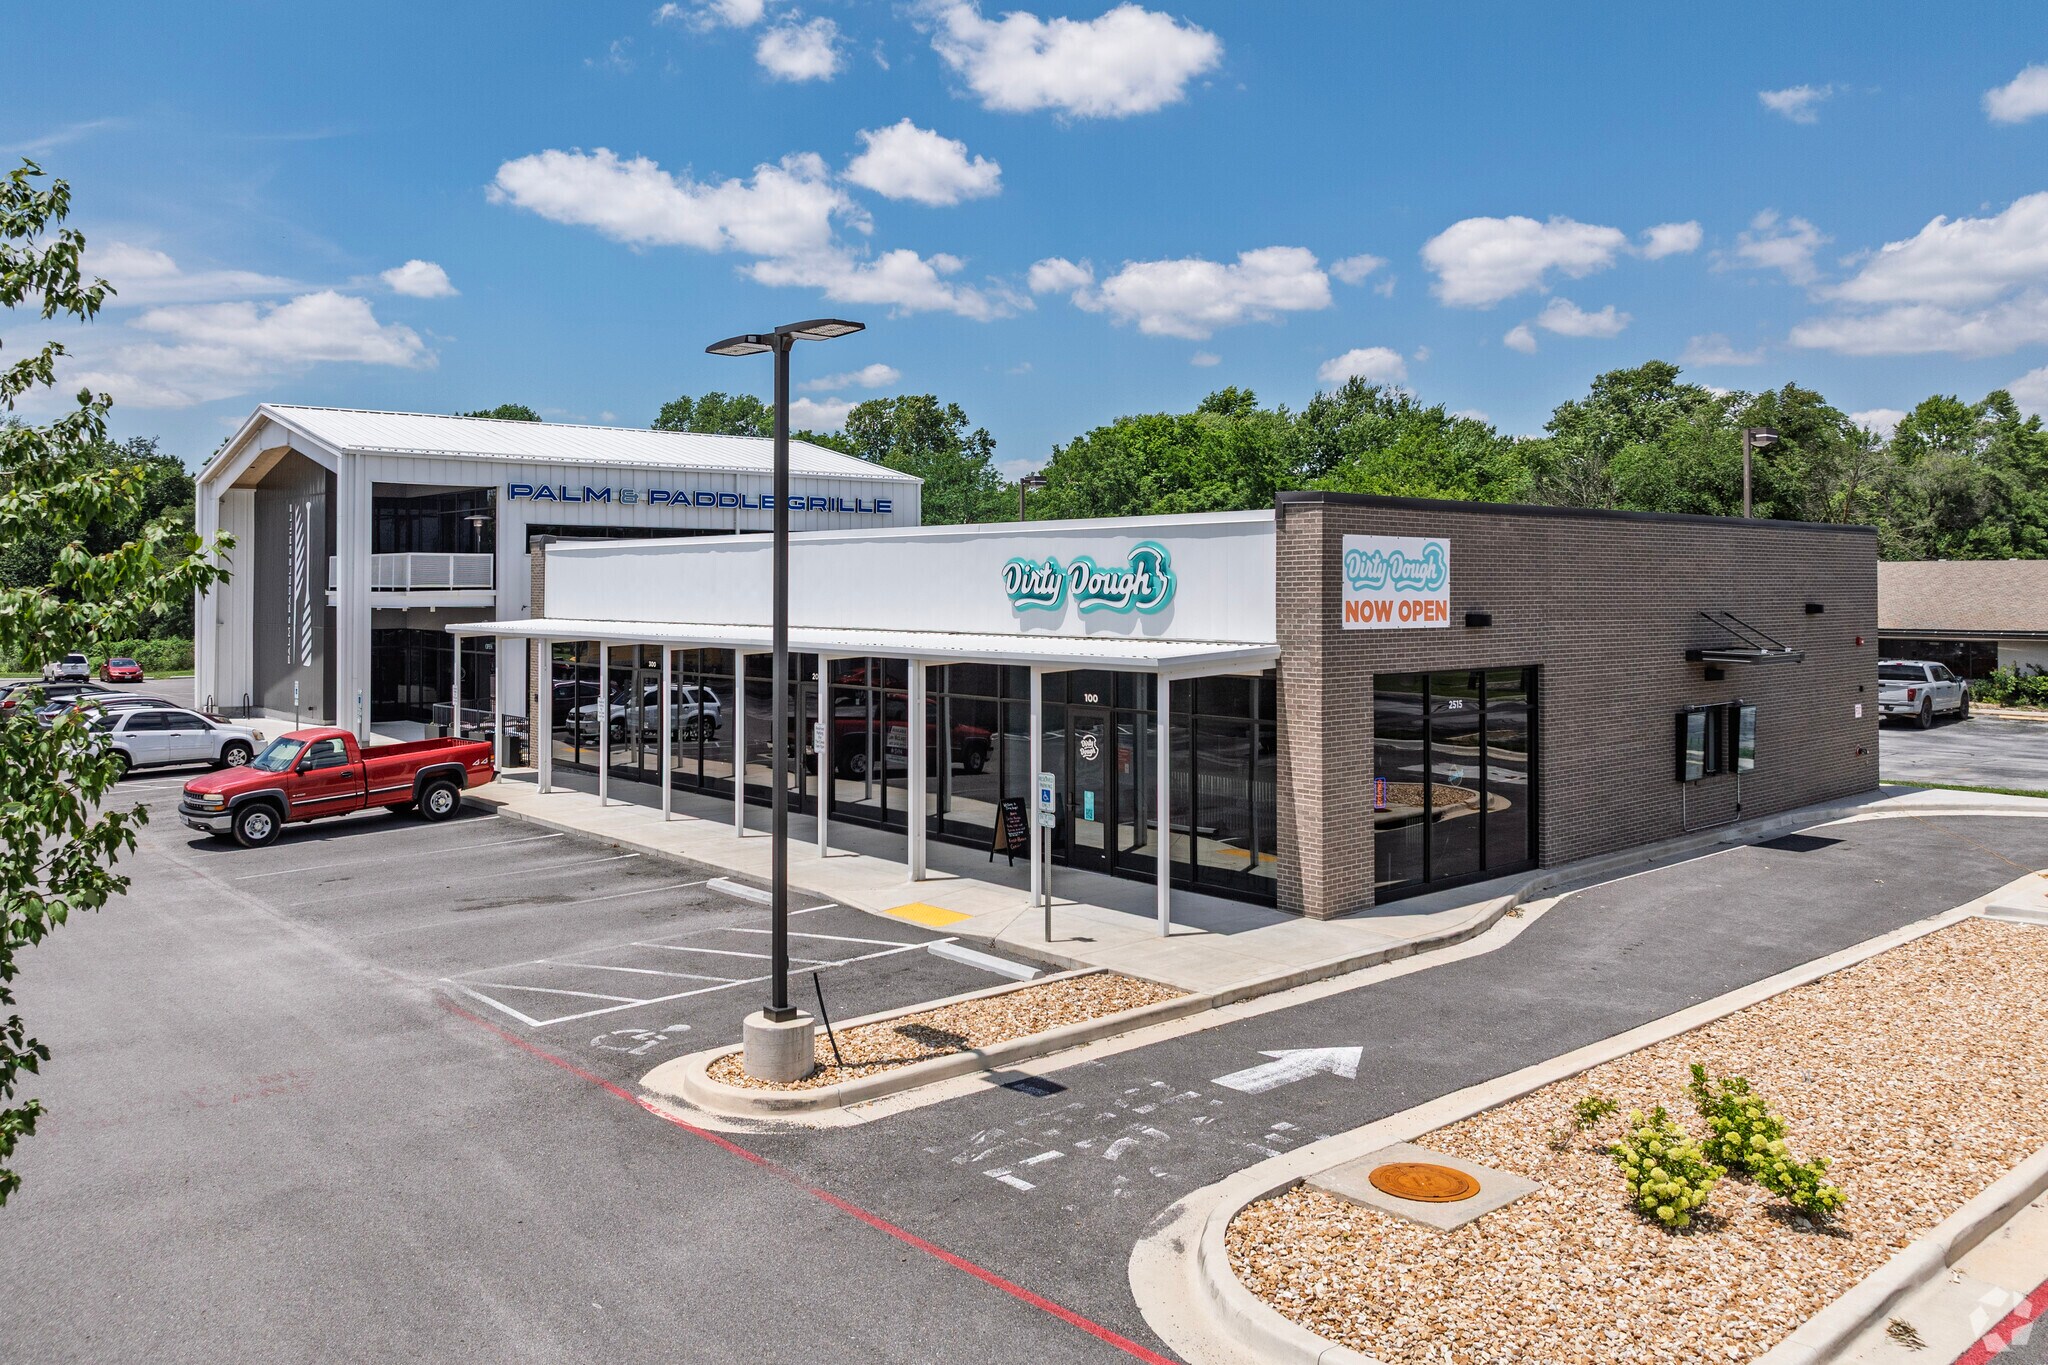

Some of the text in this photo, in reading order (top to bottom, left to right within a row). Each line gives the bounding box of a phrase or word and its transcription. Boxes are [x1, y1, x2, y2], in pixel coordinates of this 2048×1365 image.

[508, 482, 893, 514] PALM & PADDLE GRILLE
[1345, 552, 1438, 588] Dirty Dough
[1002, 558, 1156, 609] Dirty Dough
[1345, 600, 1447, 623] NOW OPEN
[648, 660, 657, 668] 300
[1084, 693, 1099, 703] 100
[1448, 699, 1463, 710] 2515
